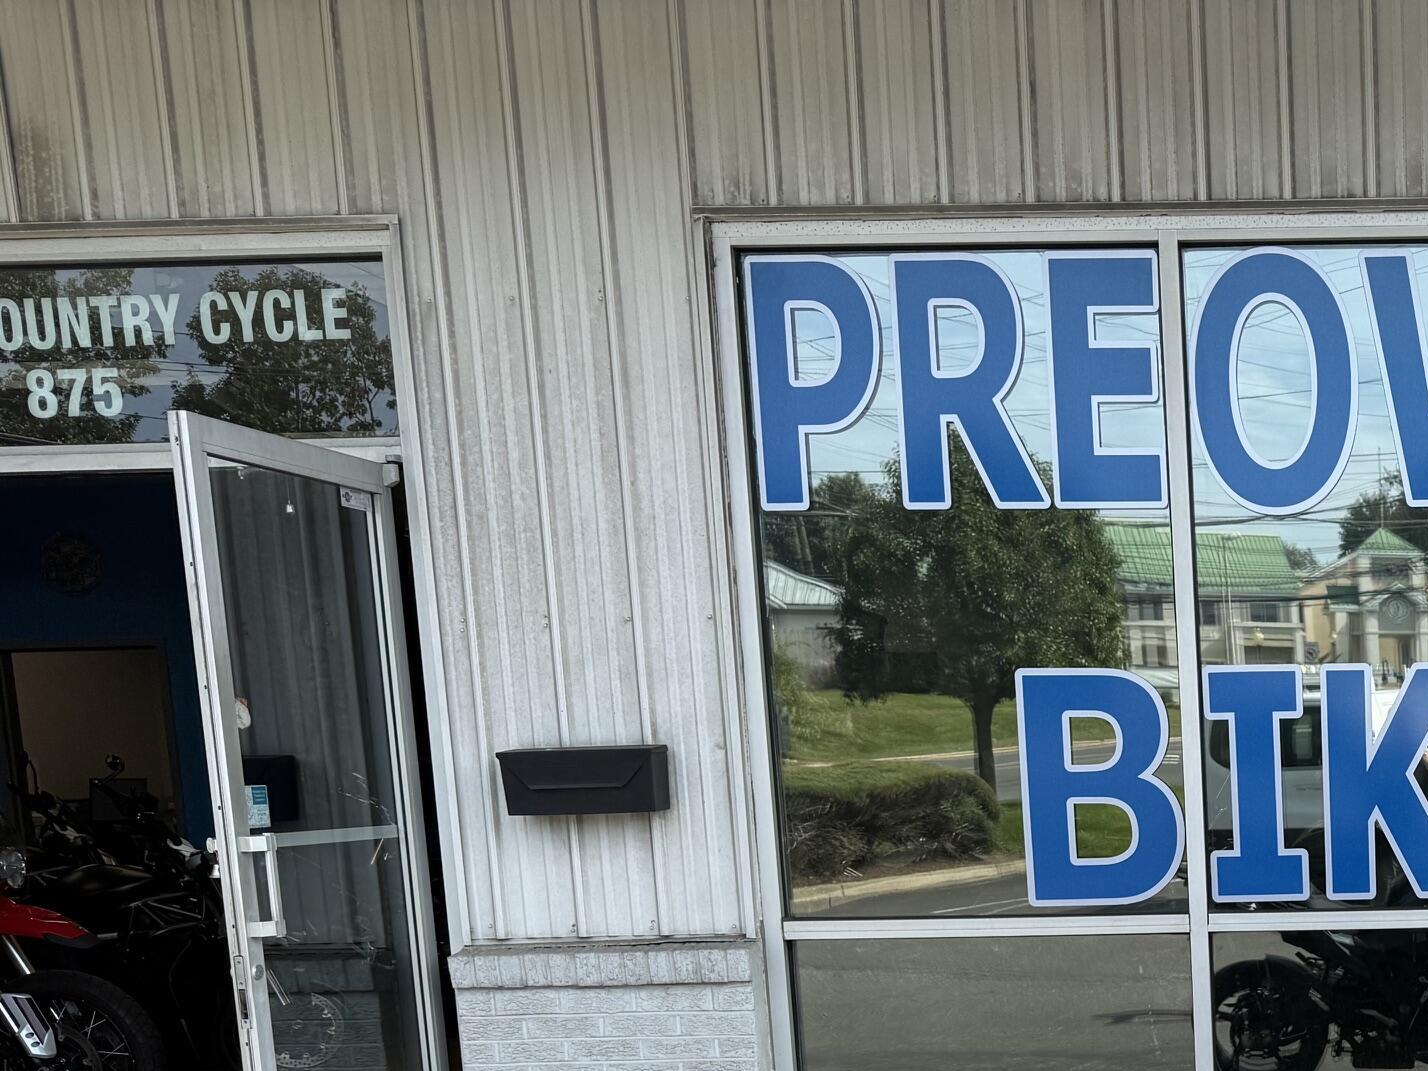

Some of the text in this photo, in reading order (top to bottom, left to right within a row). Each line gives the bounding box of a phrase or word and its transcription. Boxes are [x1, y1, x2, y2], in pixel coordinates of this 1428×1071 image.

[0, 287, 352, 350] OUNTRY CYCLE
[26, 367, 124, 419] 875
